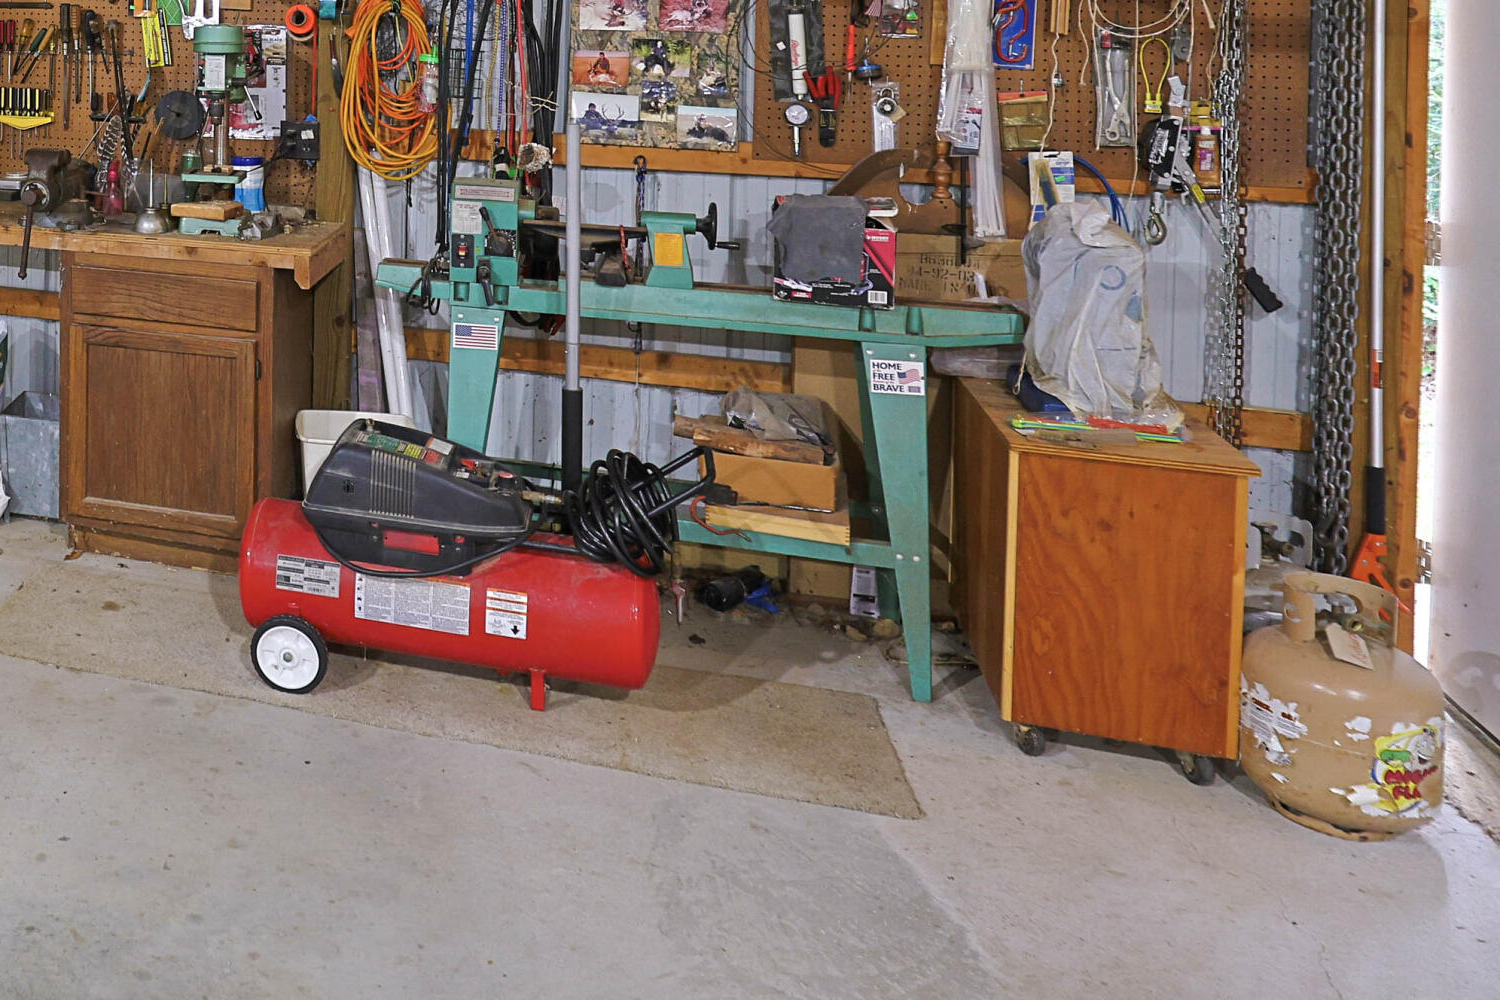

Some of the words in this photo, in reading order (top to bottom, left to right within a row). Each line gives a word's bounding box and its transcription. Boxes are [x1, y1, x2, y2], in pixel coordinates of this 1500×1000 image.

[871, 361, 903, 371] HOME
[872, 372, 896, 381] FREE
[873, 383, 905, 392] BRAVE
